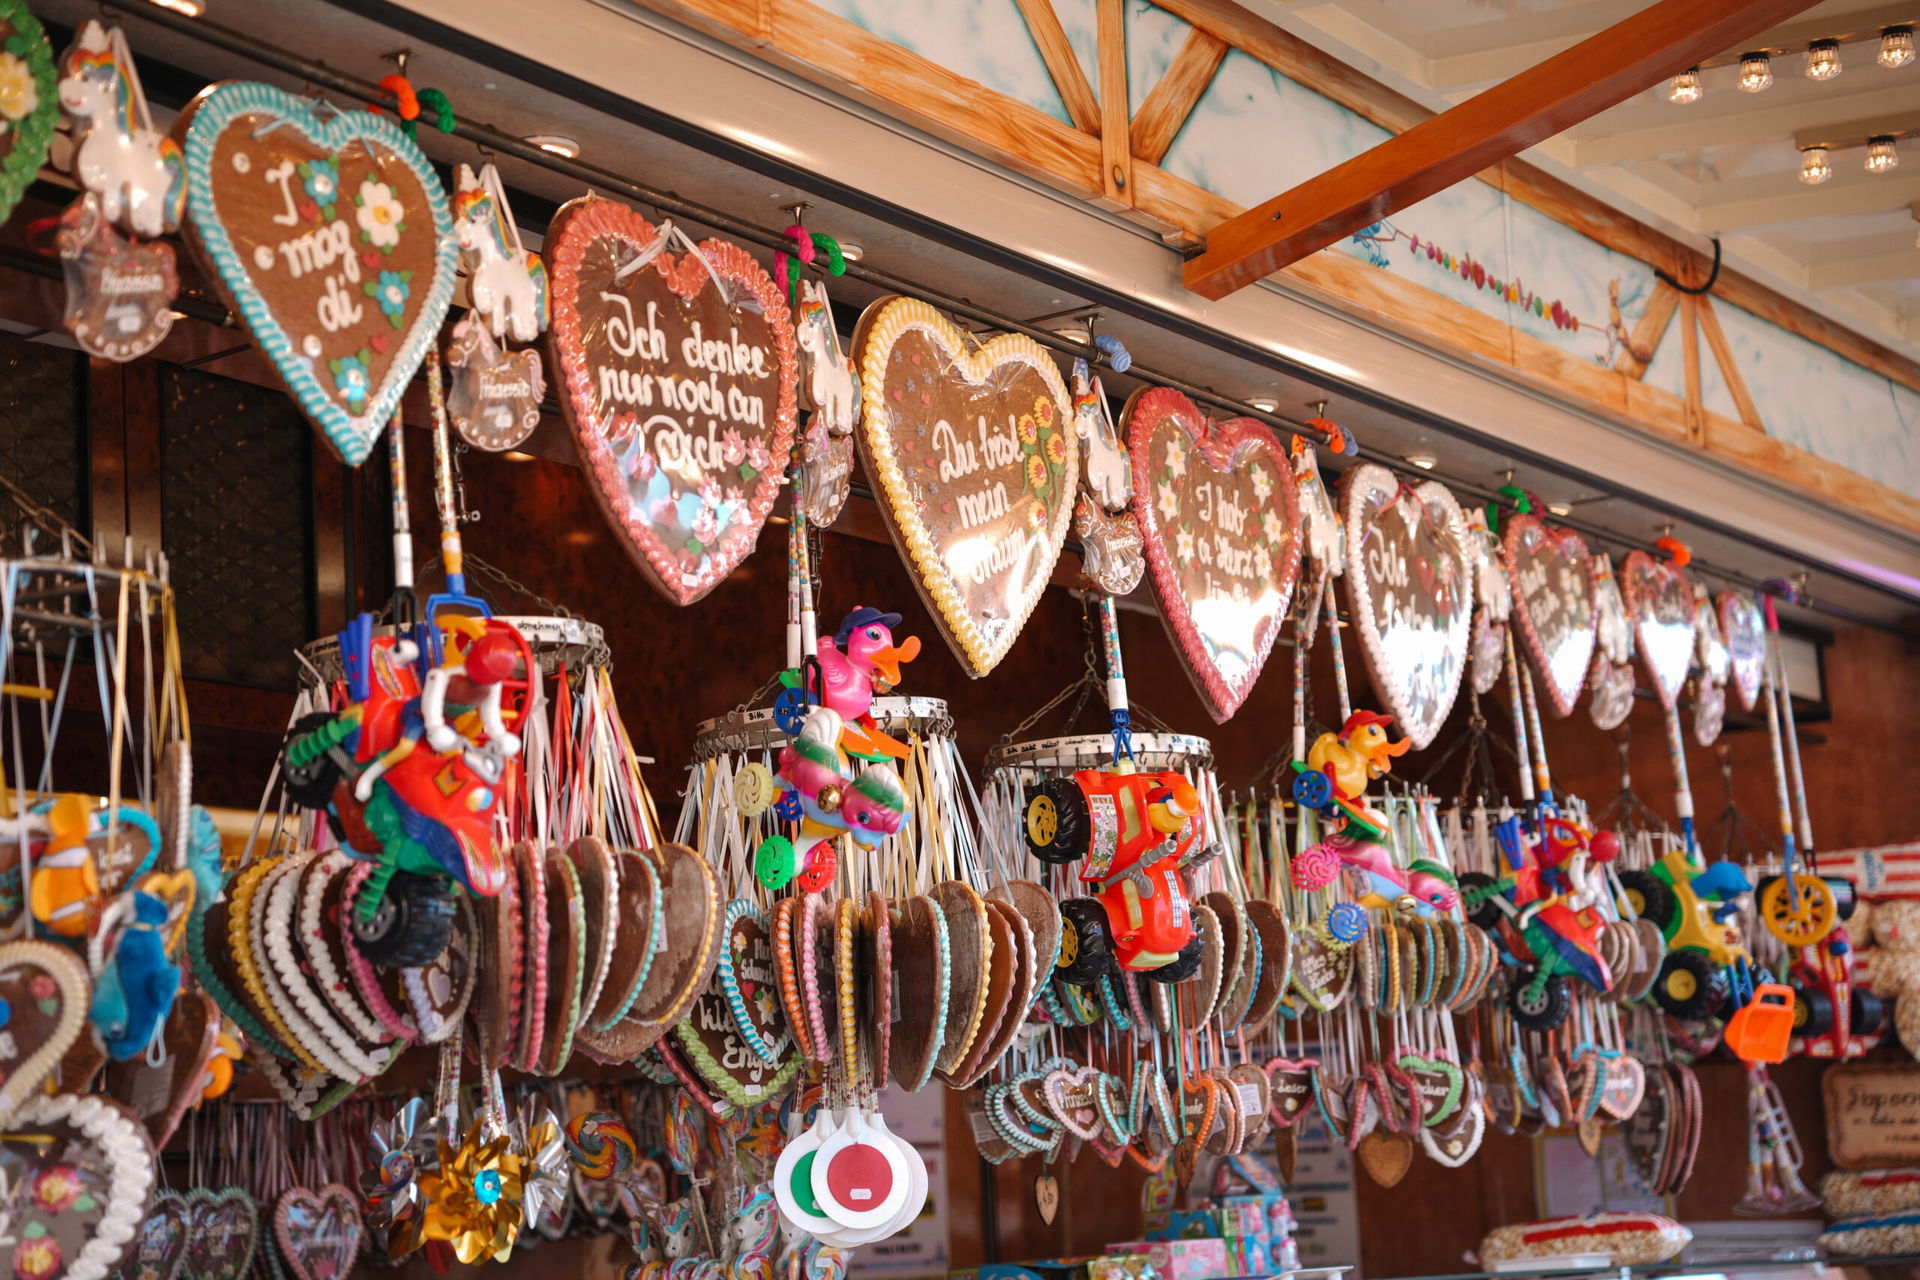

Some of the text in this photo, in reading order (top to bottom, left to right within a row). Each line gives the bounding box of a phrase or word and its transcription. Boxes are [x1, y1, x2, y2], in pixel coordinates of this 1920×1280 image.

[317, 276, 363, 332] di
[601, 291, 770, 379] Ich denke
[600, 365, 766, 429] nur noch an
[643, 414, 727, 473] Dich
[932, 414, 1026, 484] Du bist
[956, 478, 1011, 530] mein
